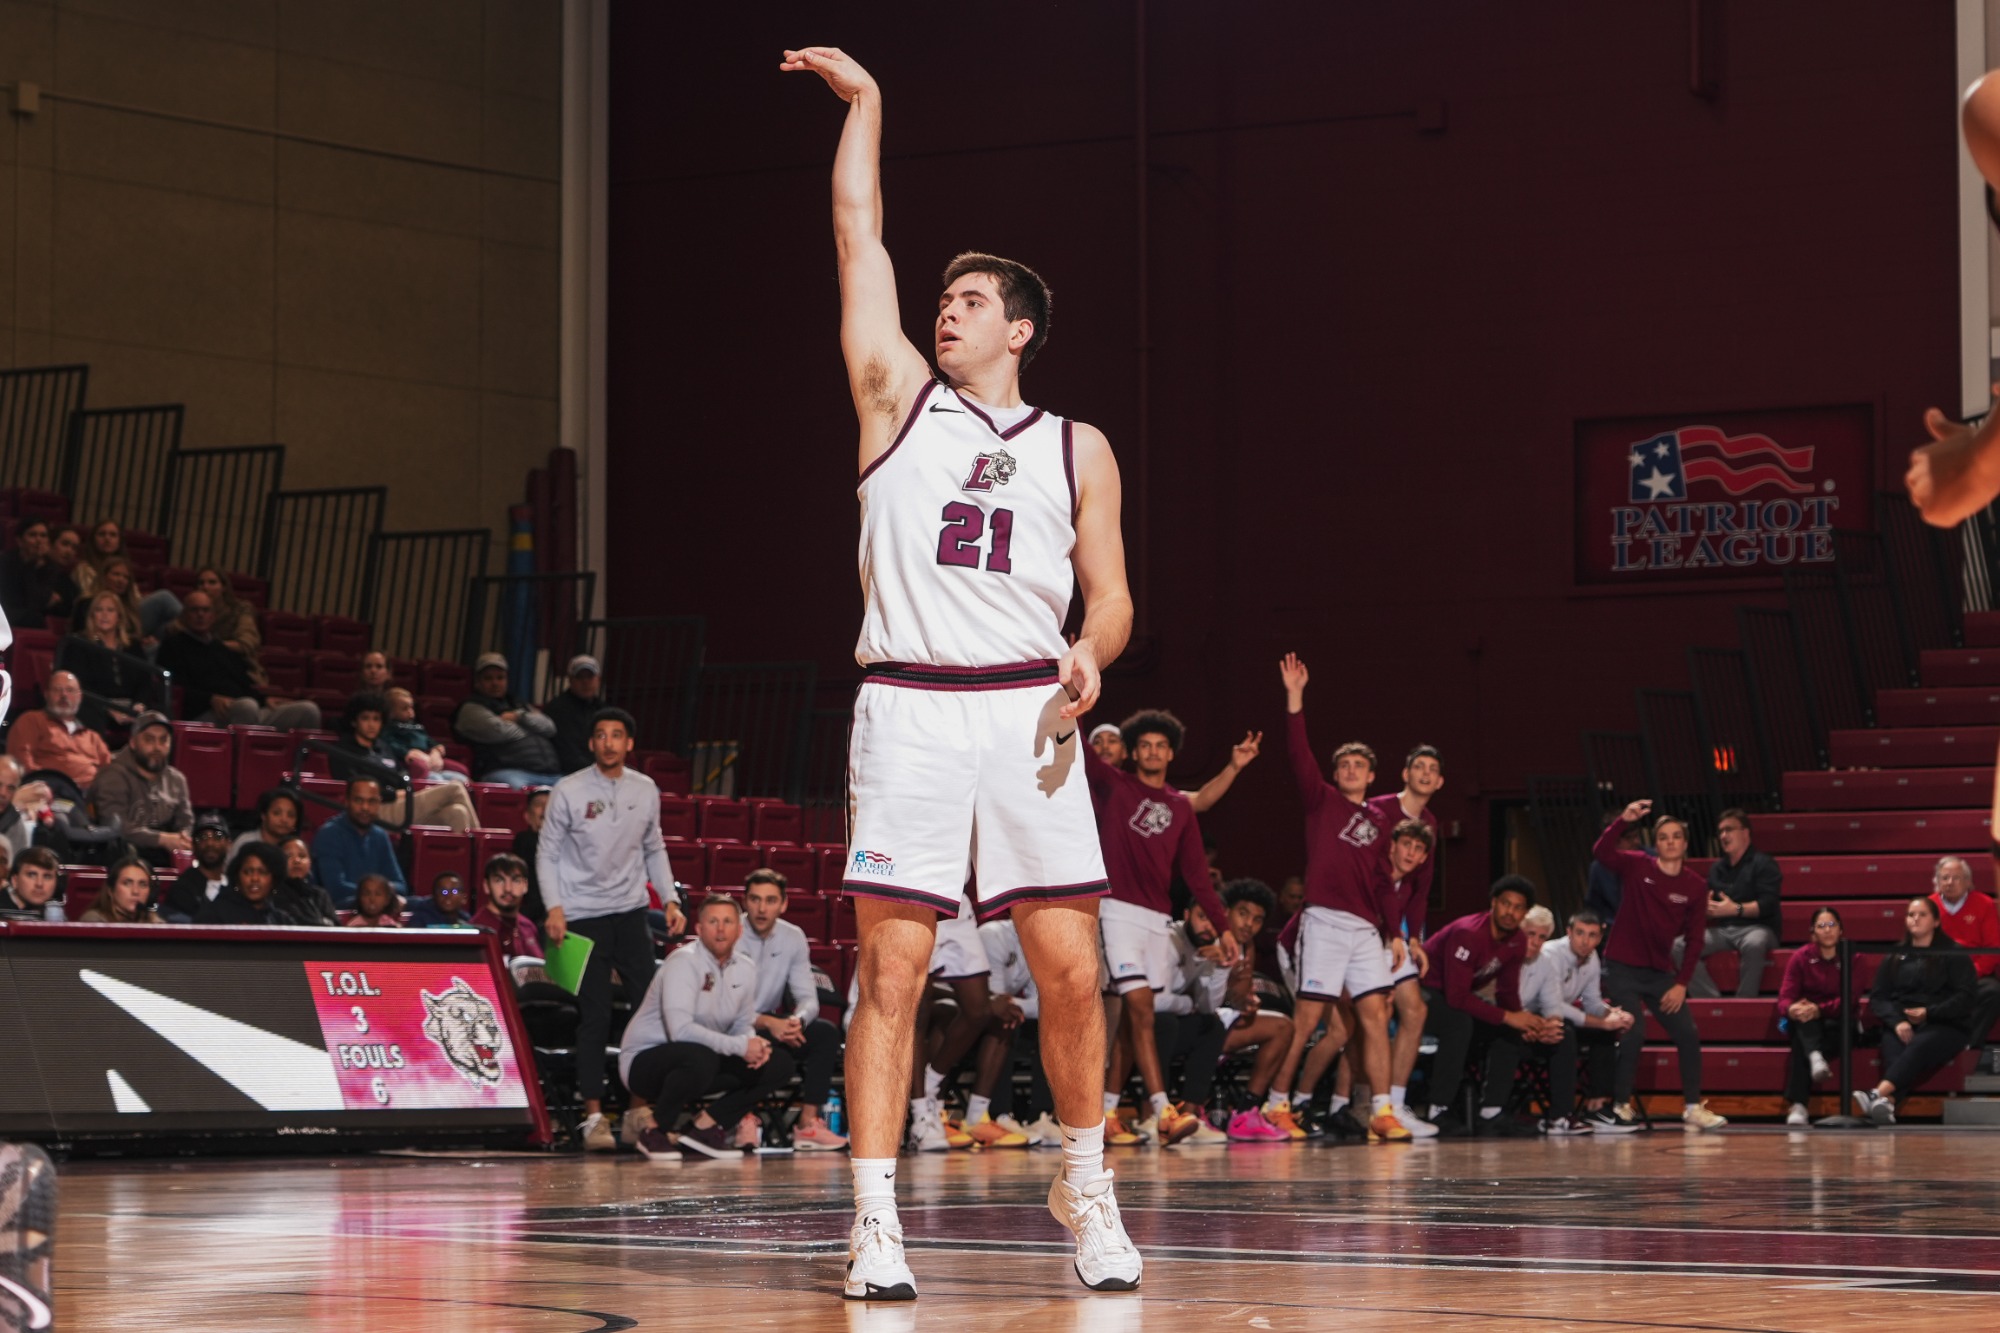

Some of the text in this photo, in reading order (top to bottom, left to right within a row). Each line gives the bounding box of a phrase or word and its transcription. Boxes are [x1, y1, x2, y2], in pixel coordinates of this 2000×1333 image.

[1611, 497, 1839, 540] PATRIOT
[936, 501, 1014, 575] 21
[1611, 532, 1836, 571] LEAGUE
[851, 867, 895, 877] LEAGUE
[852, 861, 896, 871] PATRIOT
[320, 971, 382, 996] T.O.L.
[351, 1006, 369, 1033] 3
[337, 1043, 405, 1069] FOULS
[371, 1077, 390, 1105] 6
